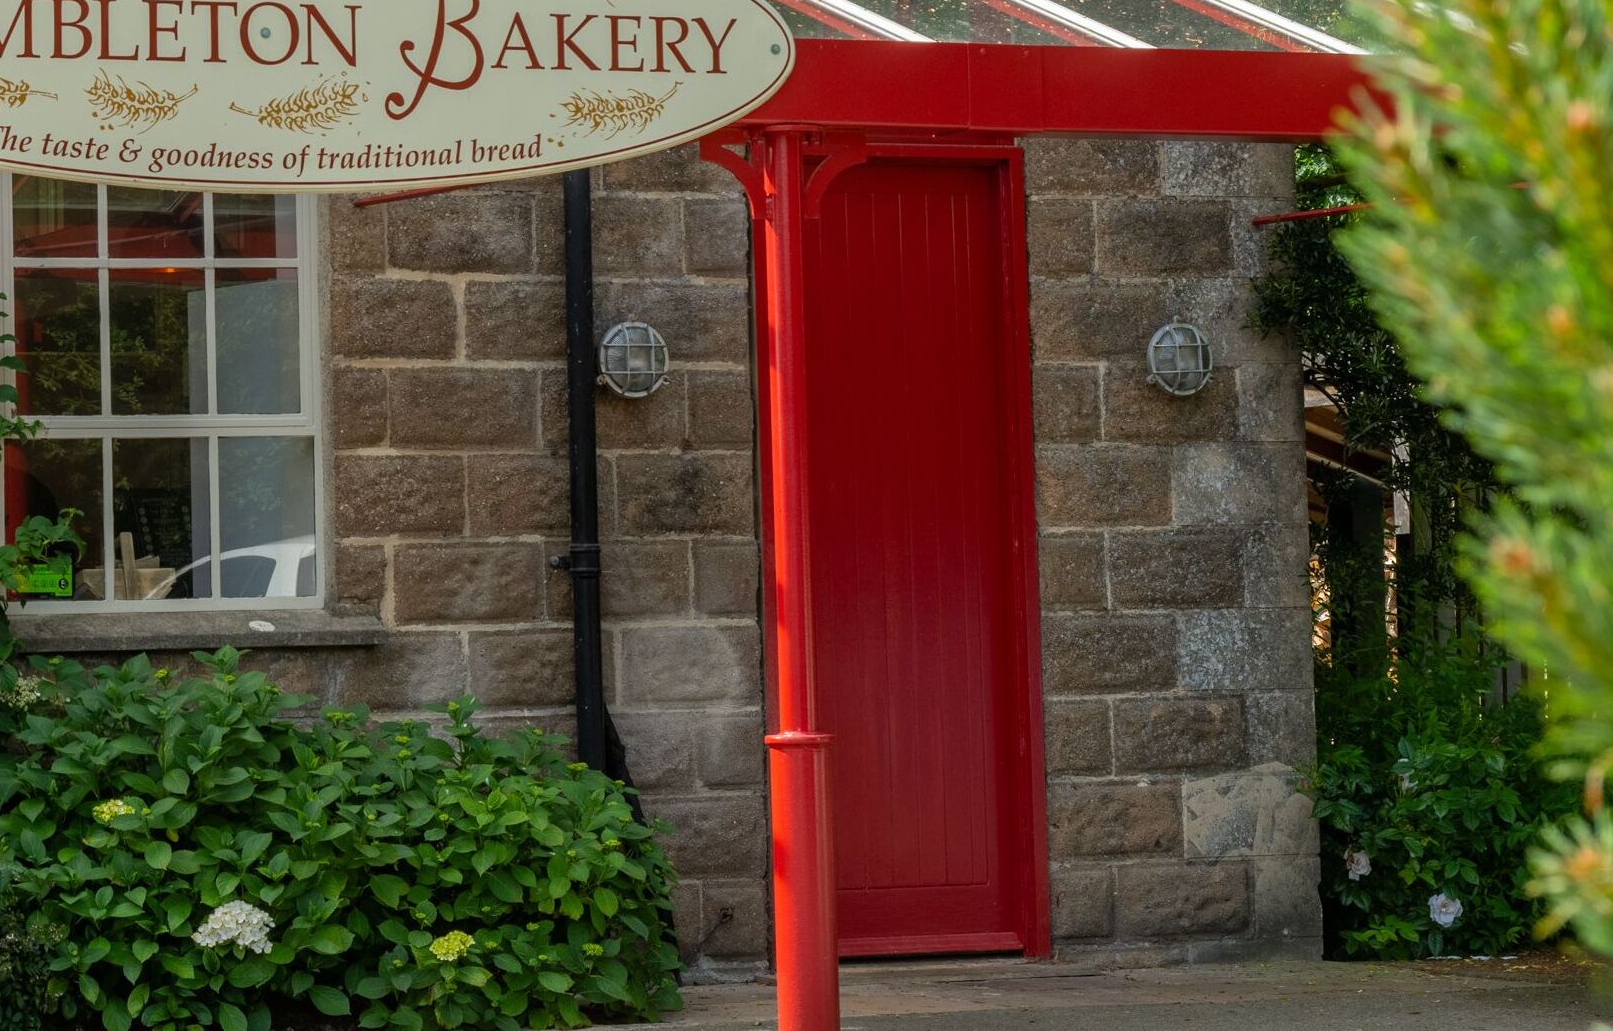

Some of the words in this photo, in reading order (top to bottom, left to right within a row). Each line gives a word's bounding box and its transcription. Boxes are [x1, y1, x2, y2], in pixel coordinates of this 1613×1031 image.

[41, 133, 109, 160] taste
[119, 138, 143, 162] &
[148, 142, 274, 173] goodness
[282, 145, 311, 177] of
[317, 140, 463, 169] traditional
[471, 133, 543, 163] bread
